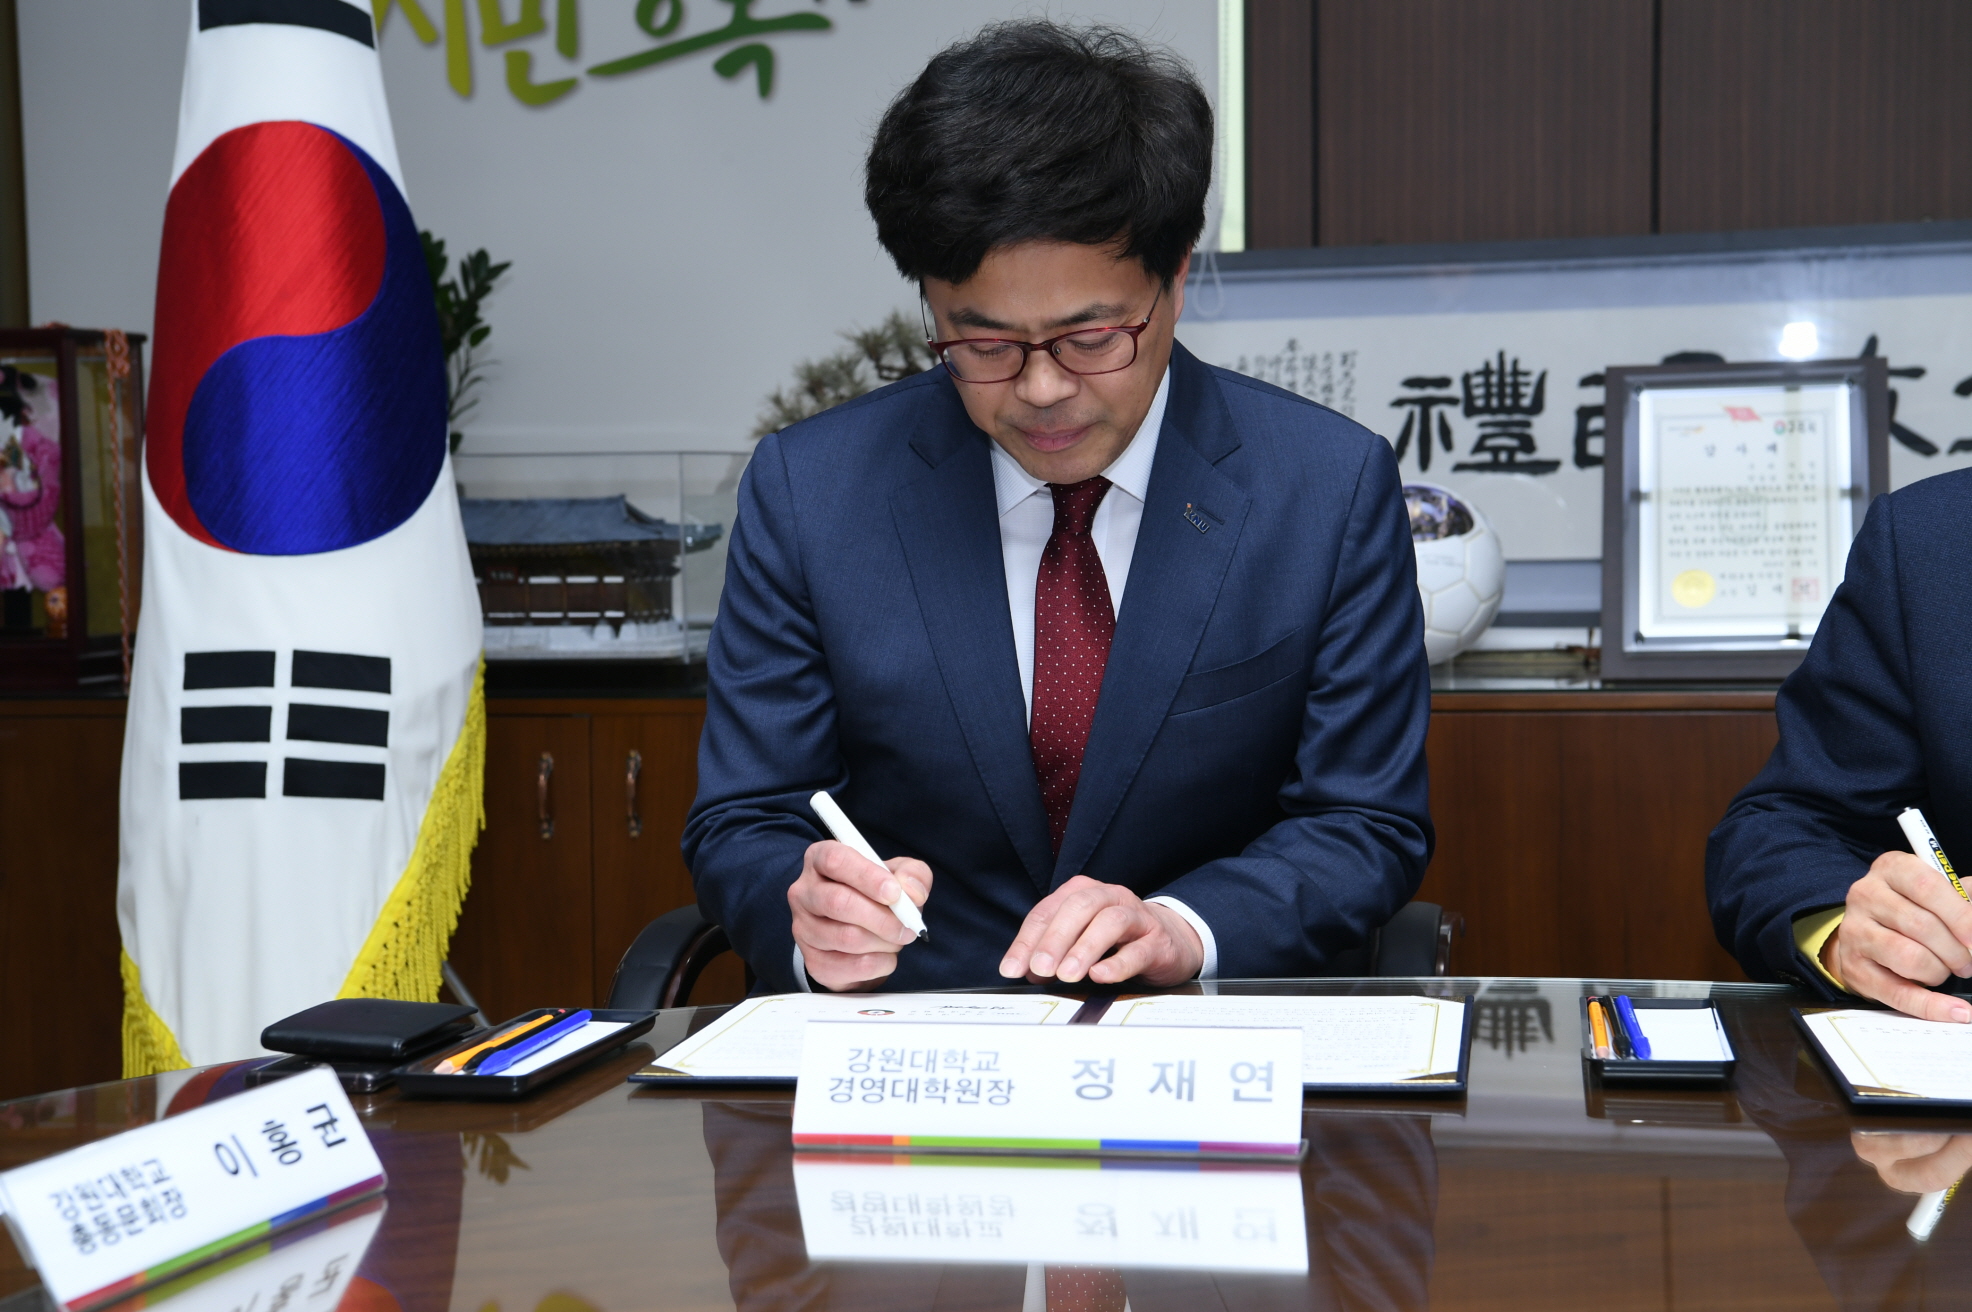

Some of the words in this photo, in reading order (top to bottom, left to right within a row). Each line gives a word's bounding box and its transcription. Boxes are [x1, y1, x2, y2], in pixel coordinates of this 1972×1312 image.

[847, 1046, 1001, 1074] 강원대학교
[828, 1076, 1015, 1106] 경영대학원장
[50, 1158, 171, 1222] 강원대학교
